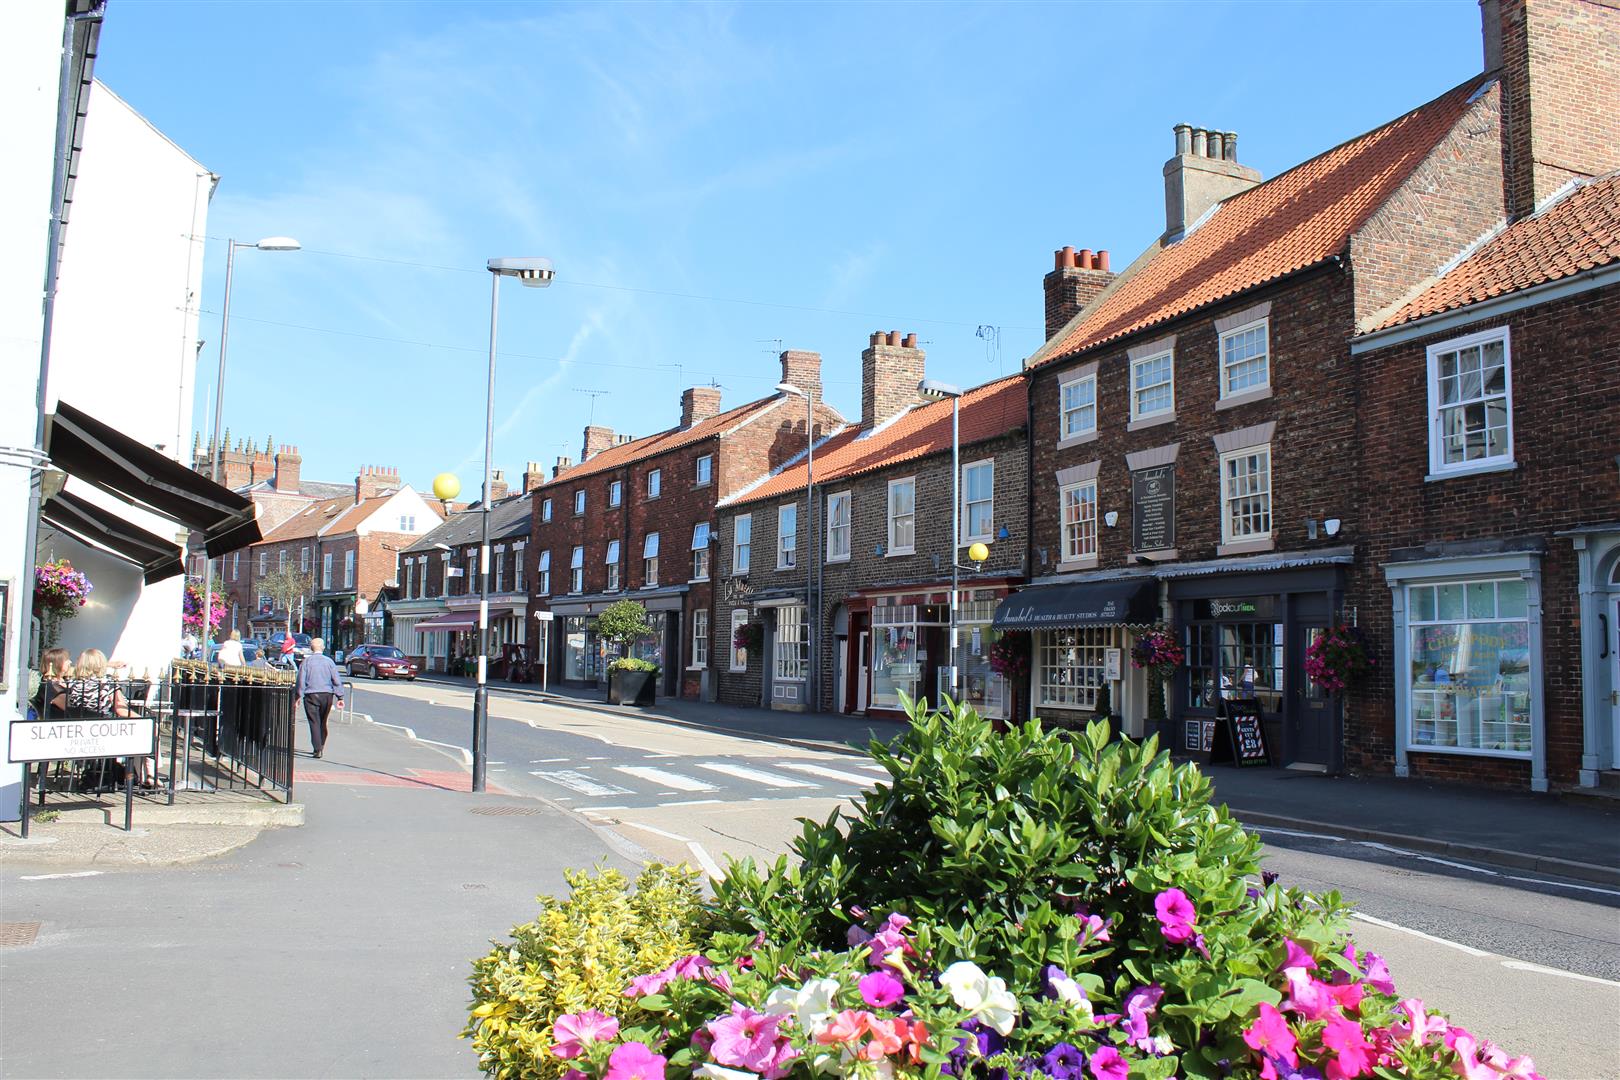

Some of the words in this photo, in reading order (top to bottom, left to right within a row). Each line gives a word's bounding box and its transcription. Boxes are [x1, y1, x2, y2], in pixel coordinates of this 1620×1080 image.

[997, 606, 1034, 624] Annabel's
[30, 724, 84, 740] SLATER
[90, 723, 136, 738] COURT
[70, 738, 99, 746] PRIVATE
[64, 747, 77, 755] NO
[80, 745, 106, 754] ACCESS
